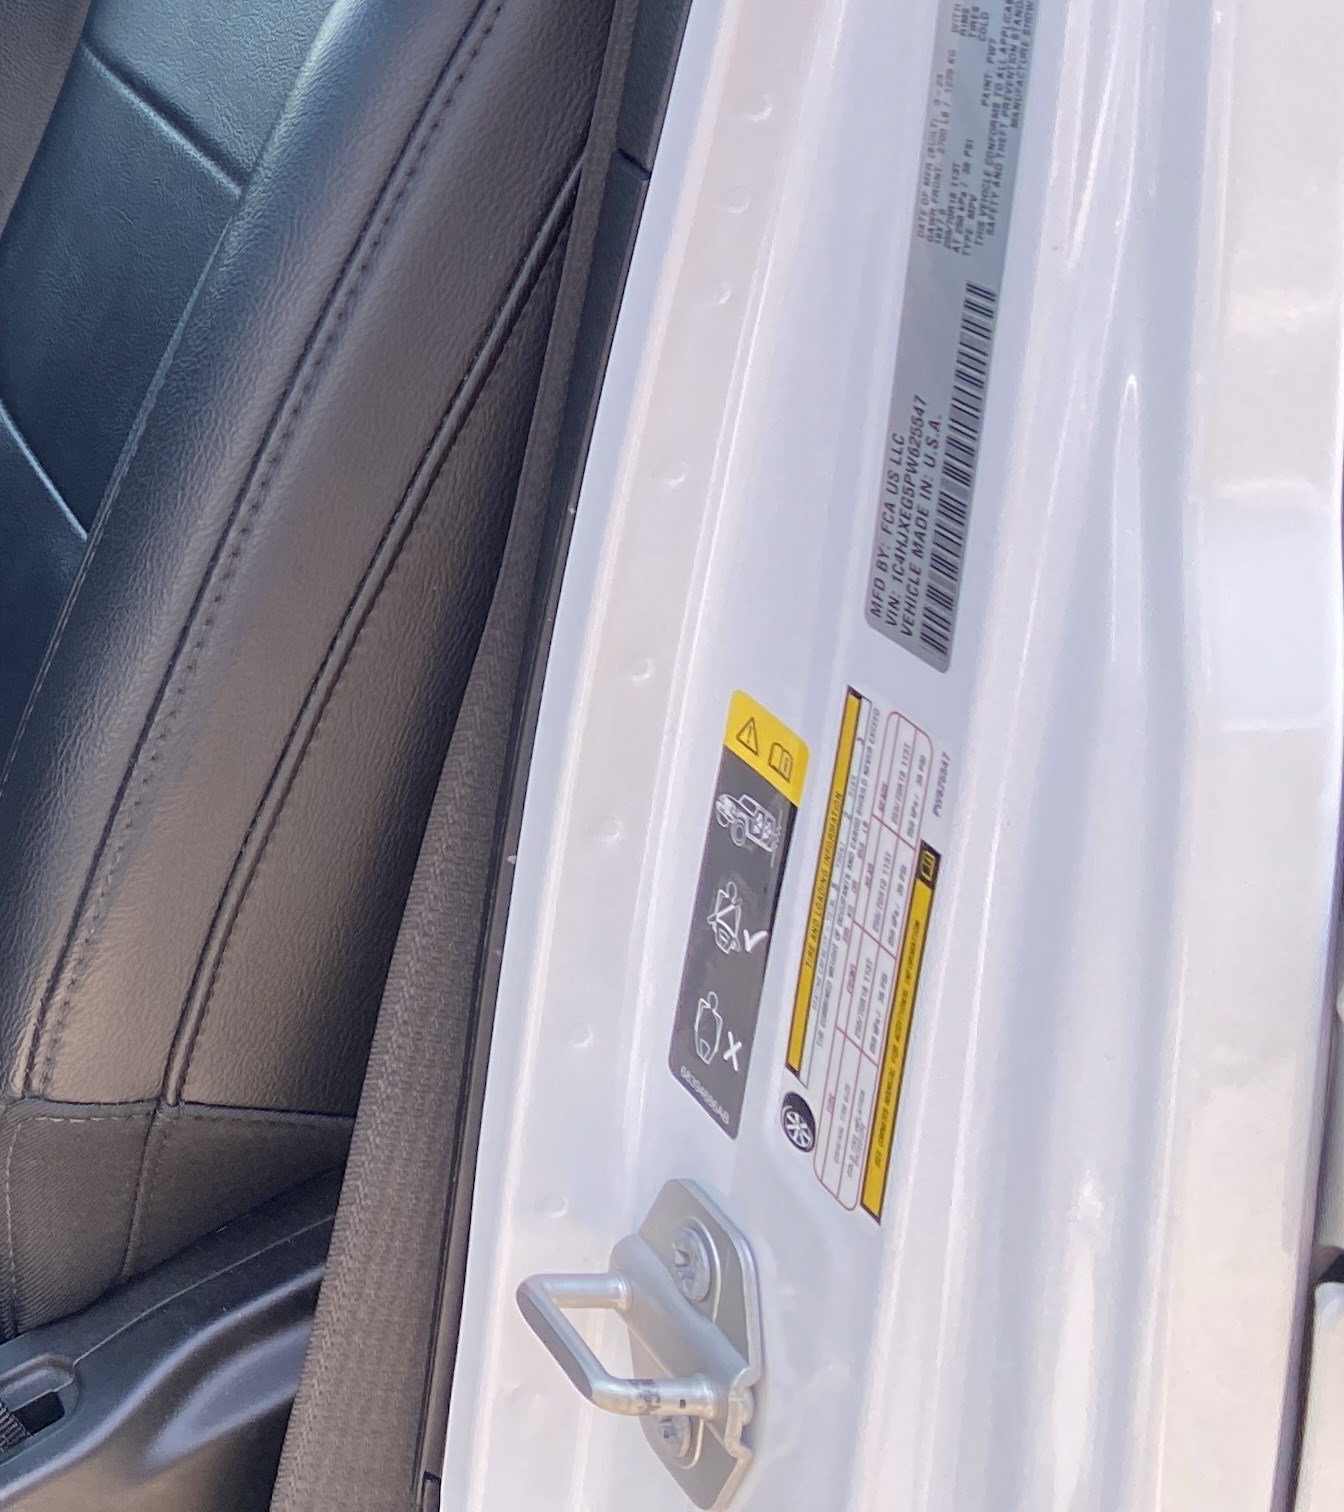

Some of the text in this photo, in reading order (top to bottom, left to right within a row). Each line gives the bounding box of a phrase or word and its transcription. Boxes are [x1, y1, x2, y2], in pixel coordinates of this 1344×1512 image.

[870, 433, 905, 618] MFD BY: FCA US LLC
[886, 590, 901, 626] VIN:
[901, 564, 921, 636] VEHICLE
[912, 507, 929, 559] MADE
[923, 415, 942, 468] U.S.A.
